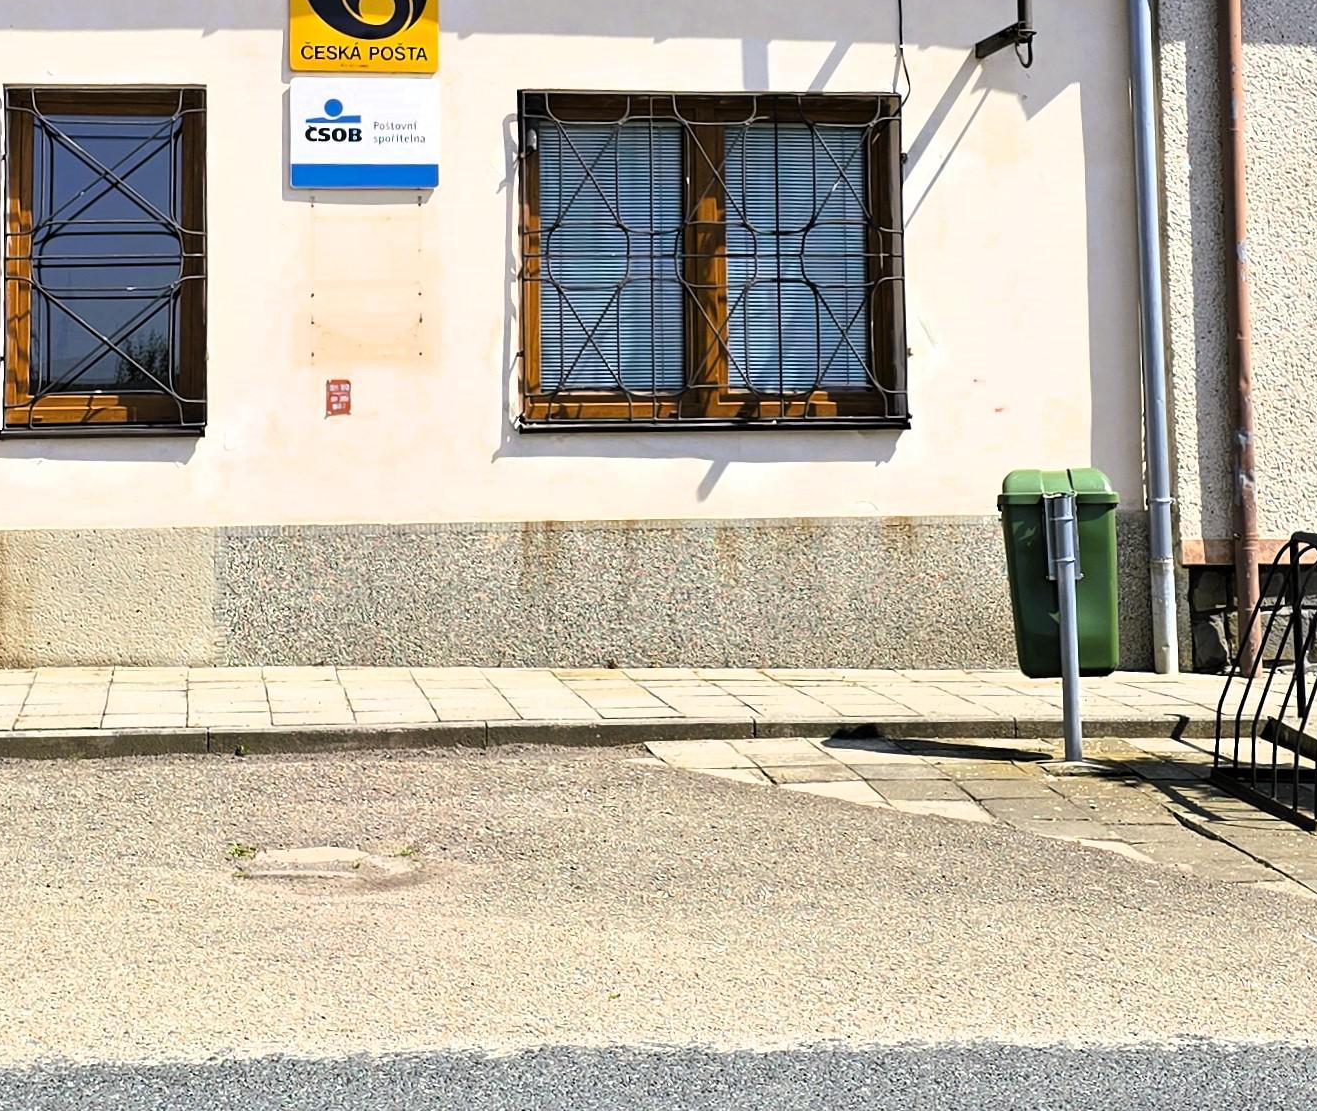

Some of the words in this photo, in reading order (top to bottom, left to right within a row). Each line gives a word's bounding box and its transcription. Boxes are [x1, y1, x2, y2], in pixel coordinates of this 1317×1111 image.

[300, 41, 362, 61] ČESKÁ
[368, 42, 428, 62] POŠTA
[373, 121, 418, 131] Poštovní
[304, 125, 363, 143] ČSOB
[373, 133, 426, 145] spořitelna
